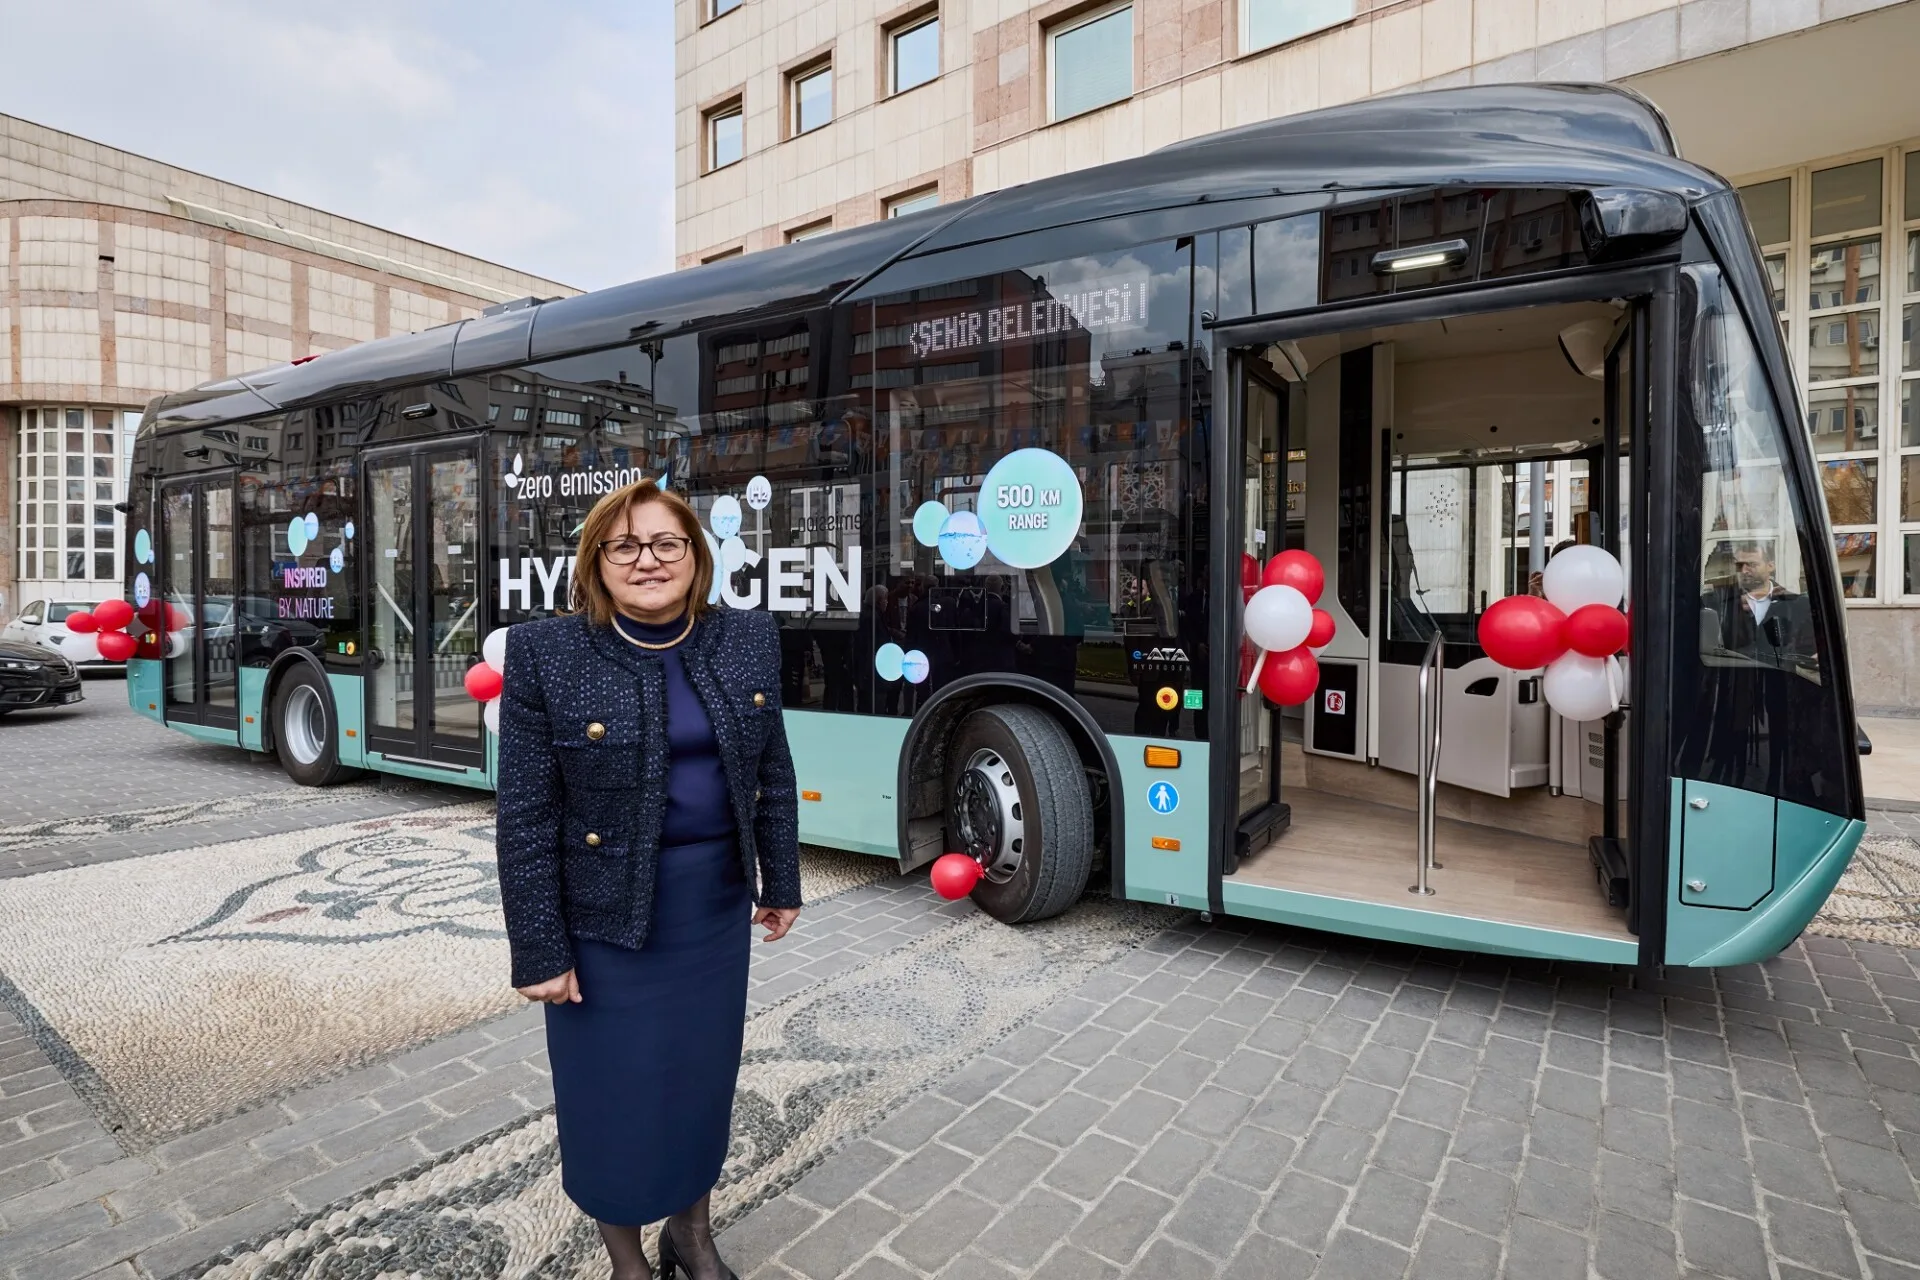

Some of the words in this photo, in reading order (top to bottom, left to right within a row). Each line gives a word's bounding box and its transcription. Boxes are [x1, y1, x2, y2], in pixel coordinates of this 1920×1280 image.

[517, 474, 552, 500] zero
[560, 463, 641, 497] emission
[997, 484, 1034, 508] 500
[1040, 489, 1061, 506] KM
[1009, 512, 1048, 530] RANGE
[284, 567, 327, 588] INSPIRED
[278, 597, 292, 618] BY
[295, 597, 335, 619] NATURE
